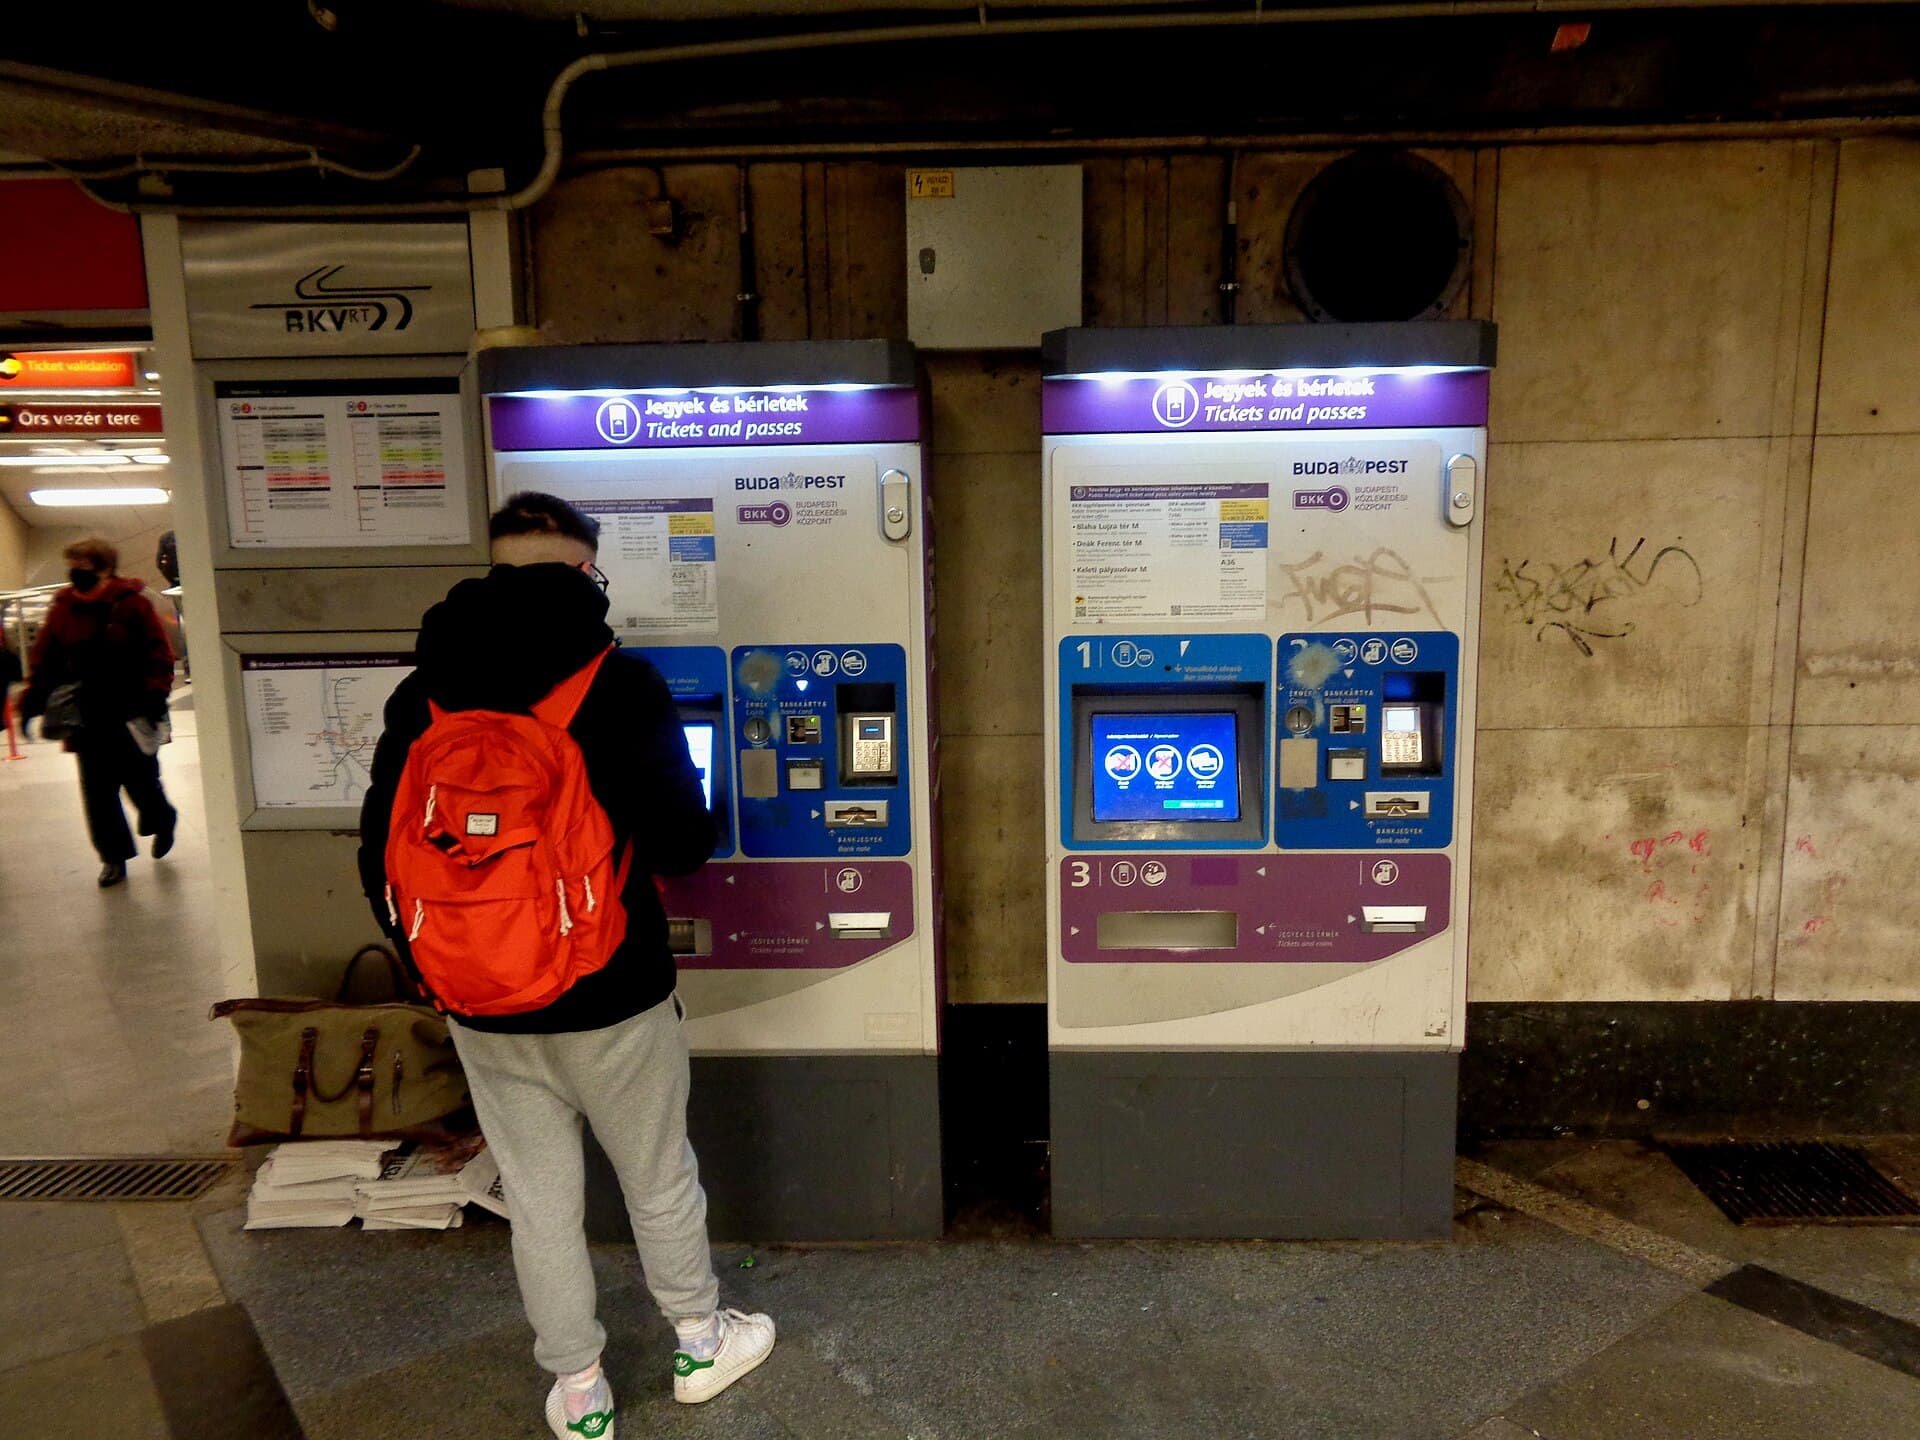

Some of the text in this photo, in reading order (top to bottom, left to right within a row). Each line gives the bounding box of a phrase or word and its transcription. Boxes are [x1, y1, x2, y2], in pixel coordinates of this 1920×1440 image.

[1203, 375, 1375, 404] Jegyek és bérletek
[644, 393, 809, 418] Jegyek és bérletek
[53, 410, 101, 426] vezér
[106, 412, 141, 426] tere
[1204, 403, 1367, 425] Tickets and passes
[646, 418, 803, 440] Tickets and passes
[1355, 486, 1399, 494] BUDAPESTI
[796, 500, 838, 508] BUDAPESTI
[1300, 495, 1325, 505] BKK
[744, 510, 768, 520] BKK
[1076, 641, 1092, 668] 1
[1324, 688, 1375, 698] BANKKÁRTYA
[779, 699, 827, 708] BANKKÁRTYA
[1071, 860, 1091, 888] 3
